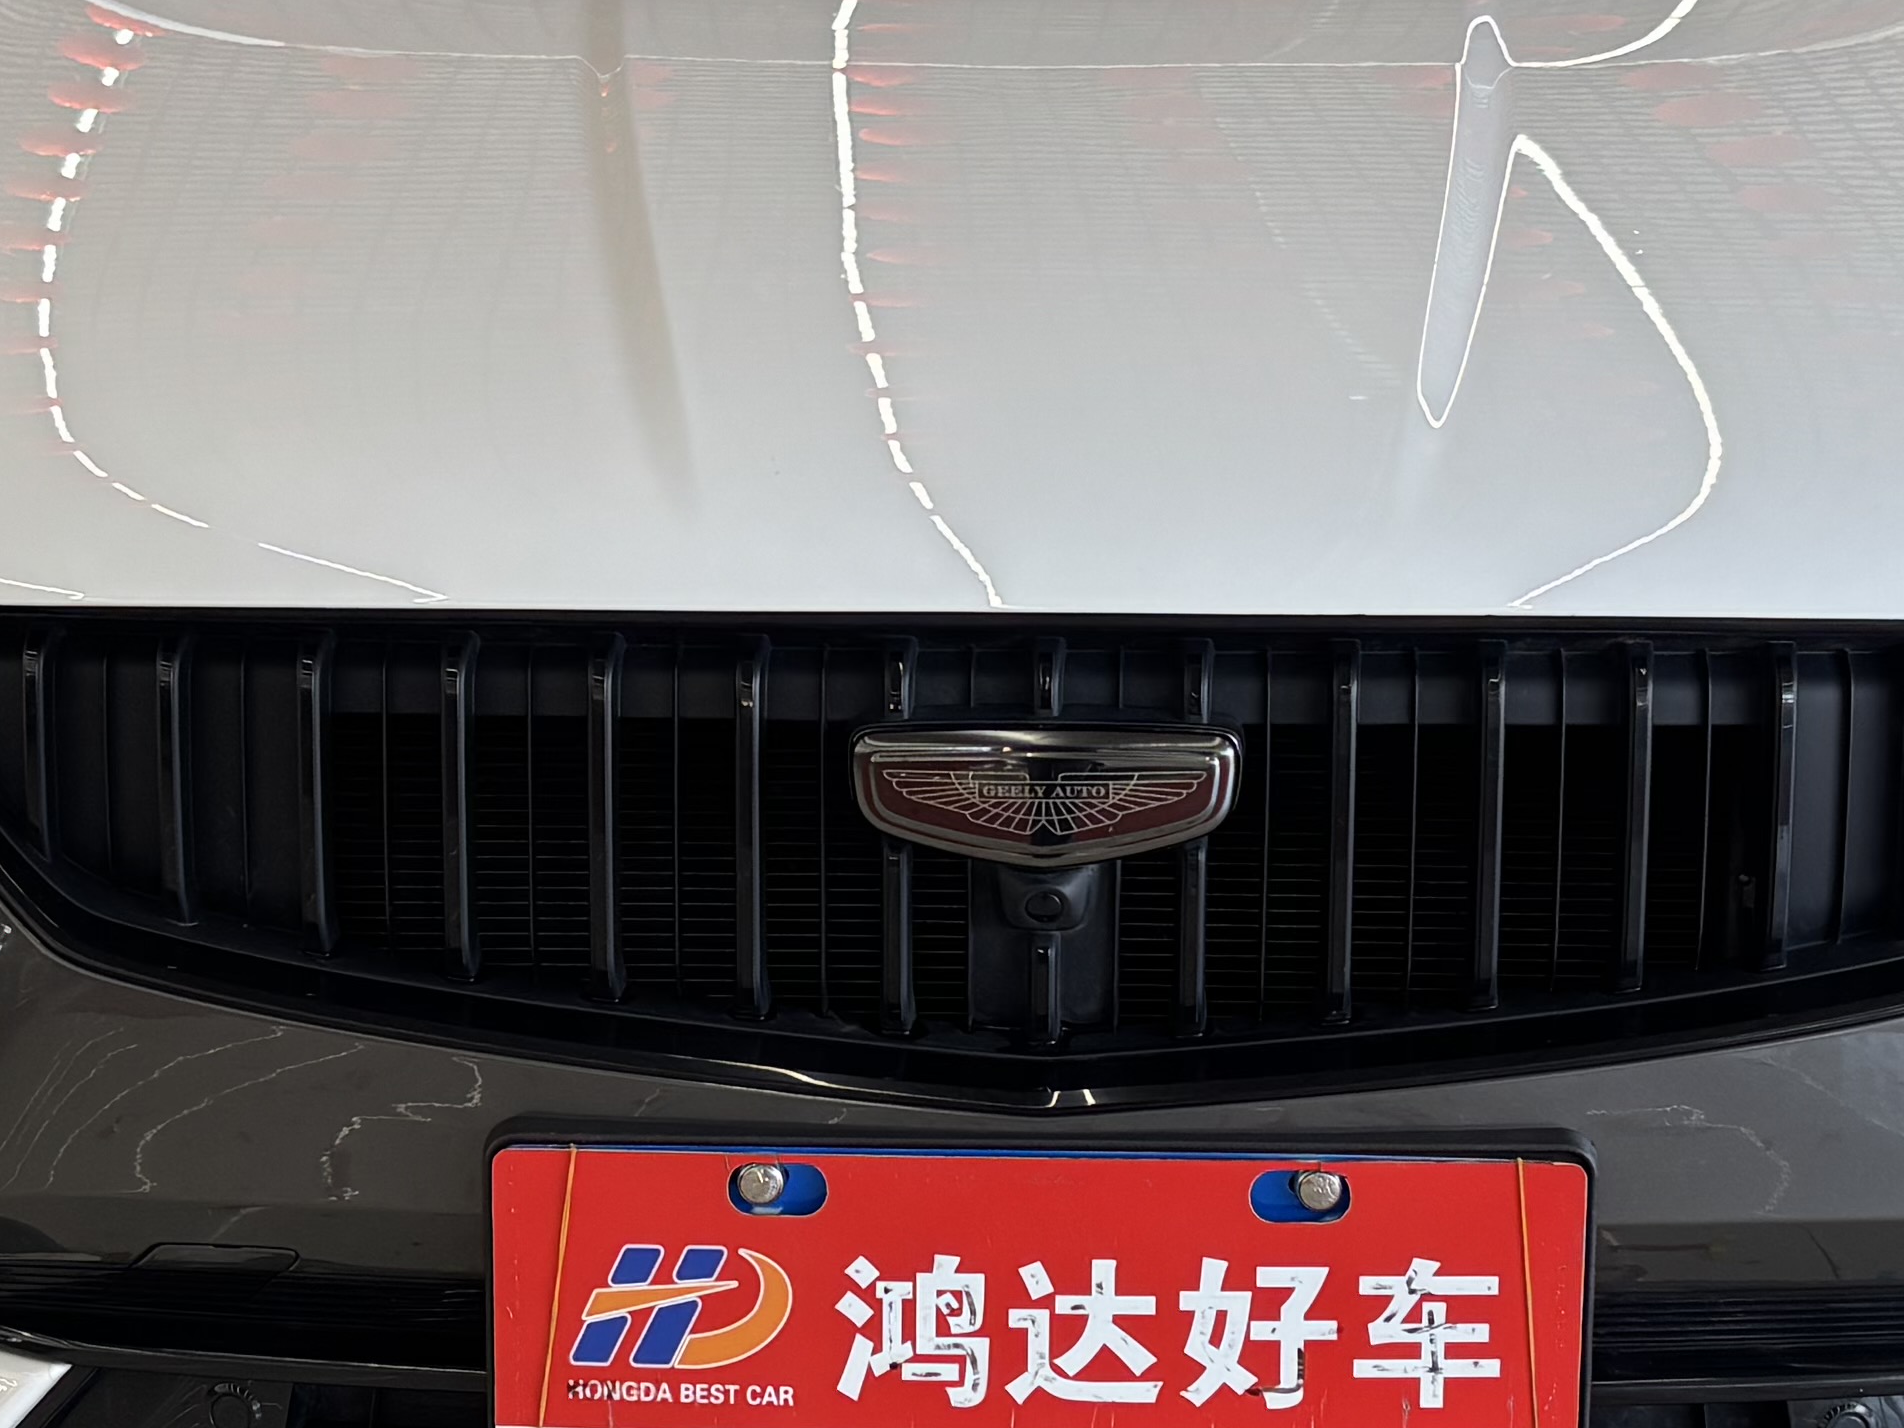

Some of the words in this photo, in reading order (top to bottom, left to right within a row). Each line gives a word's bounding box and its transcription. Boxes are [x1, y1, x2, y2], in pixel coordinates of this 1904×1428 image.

[982, 785, 1046, 798] GEELY
[1050, 785, 1106, 798] AUTO
[834, 1254, 1501, 1408] 鸿达好车
[567, 1378, 673, 1403] HONGDA
[679, 1383, 740, 1405] BEST
[746, 1385, 795, 1407] CAR
